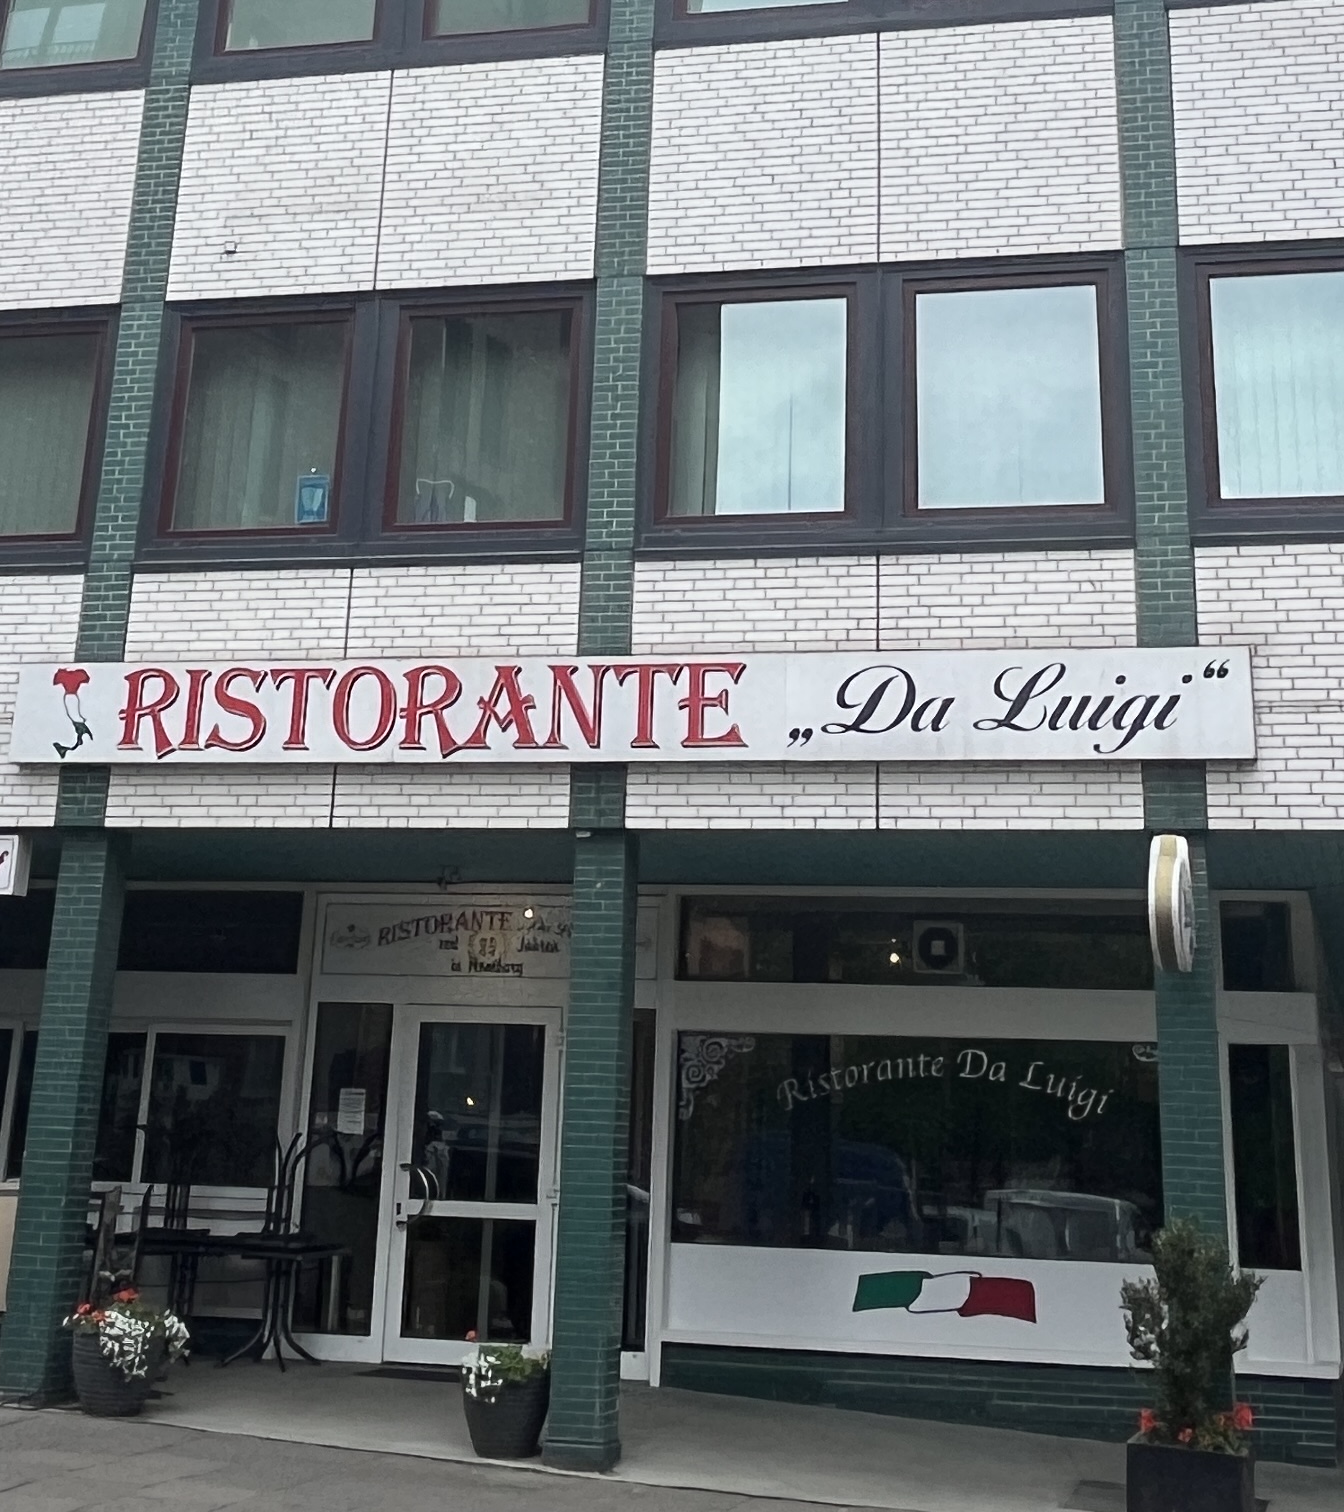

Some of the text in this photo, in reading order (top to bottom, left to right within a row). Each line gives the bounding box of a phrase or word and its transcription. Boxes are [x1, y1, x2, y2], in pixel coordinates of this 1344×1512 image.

[116, 660, 750, 761] RISTORANTE
[376, 909, 514, 948] RISTORANTE
[776, 1048, 1116, 1121] Ristorante Da Luigi
